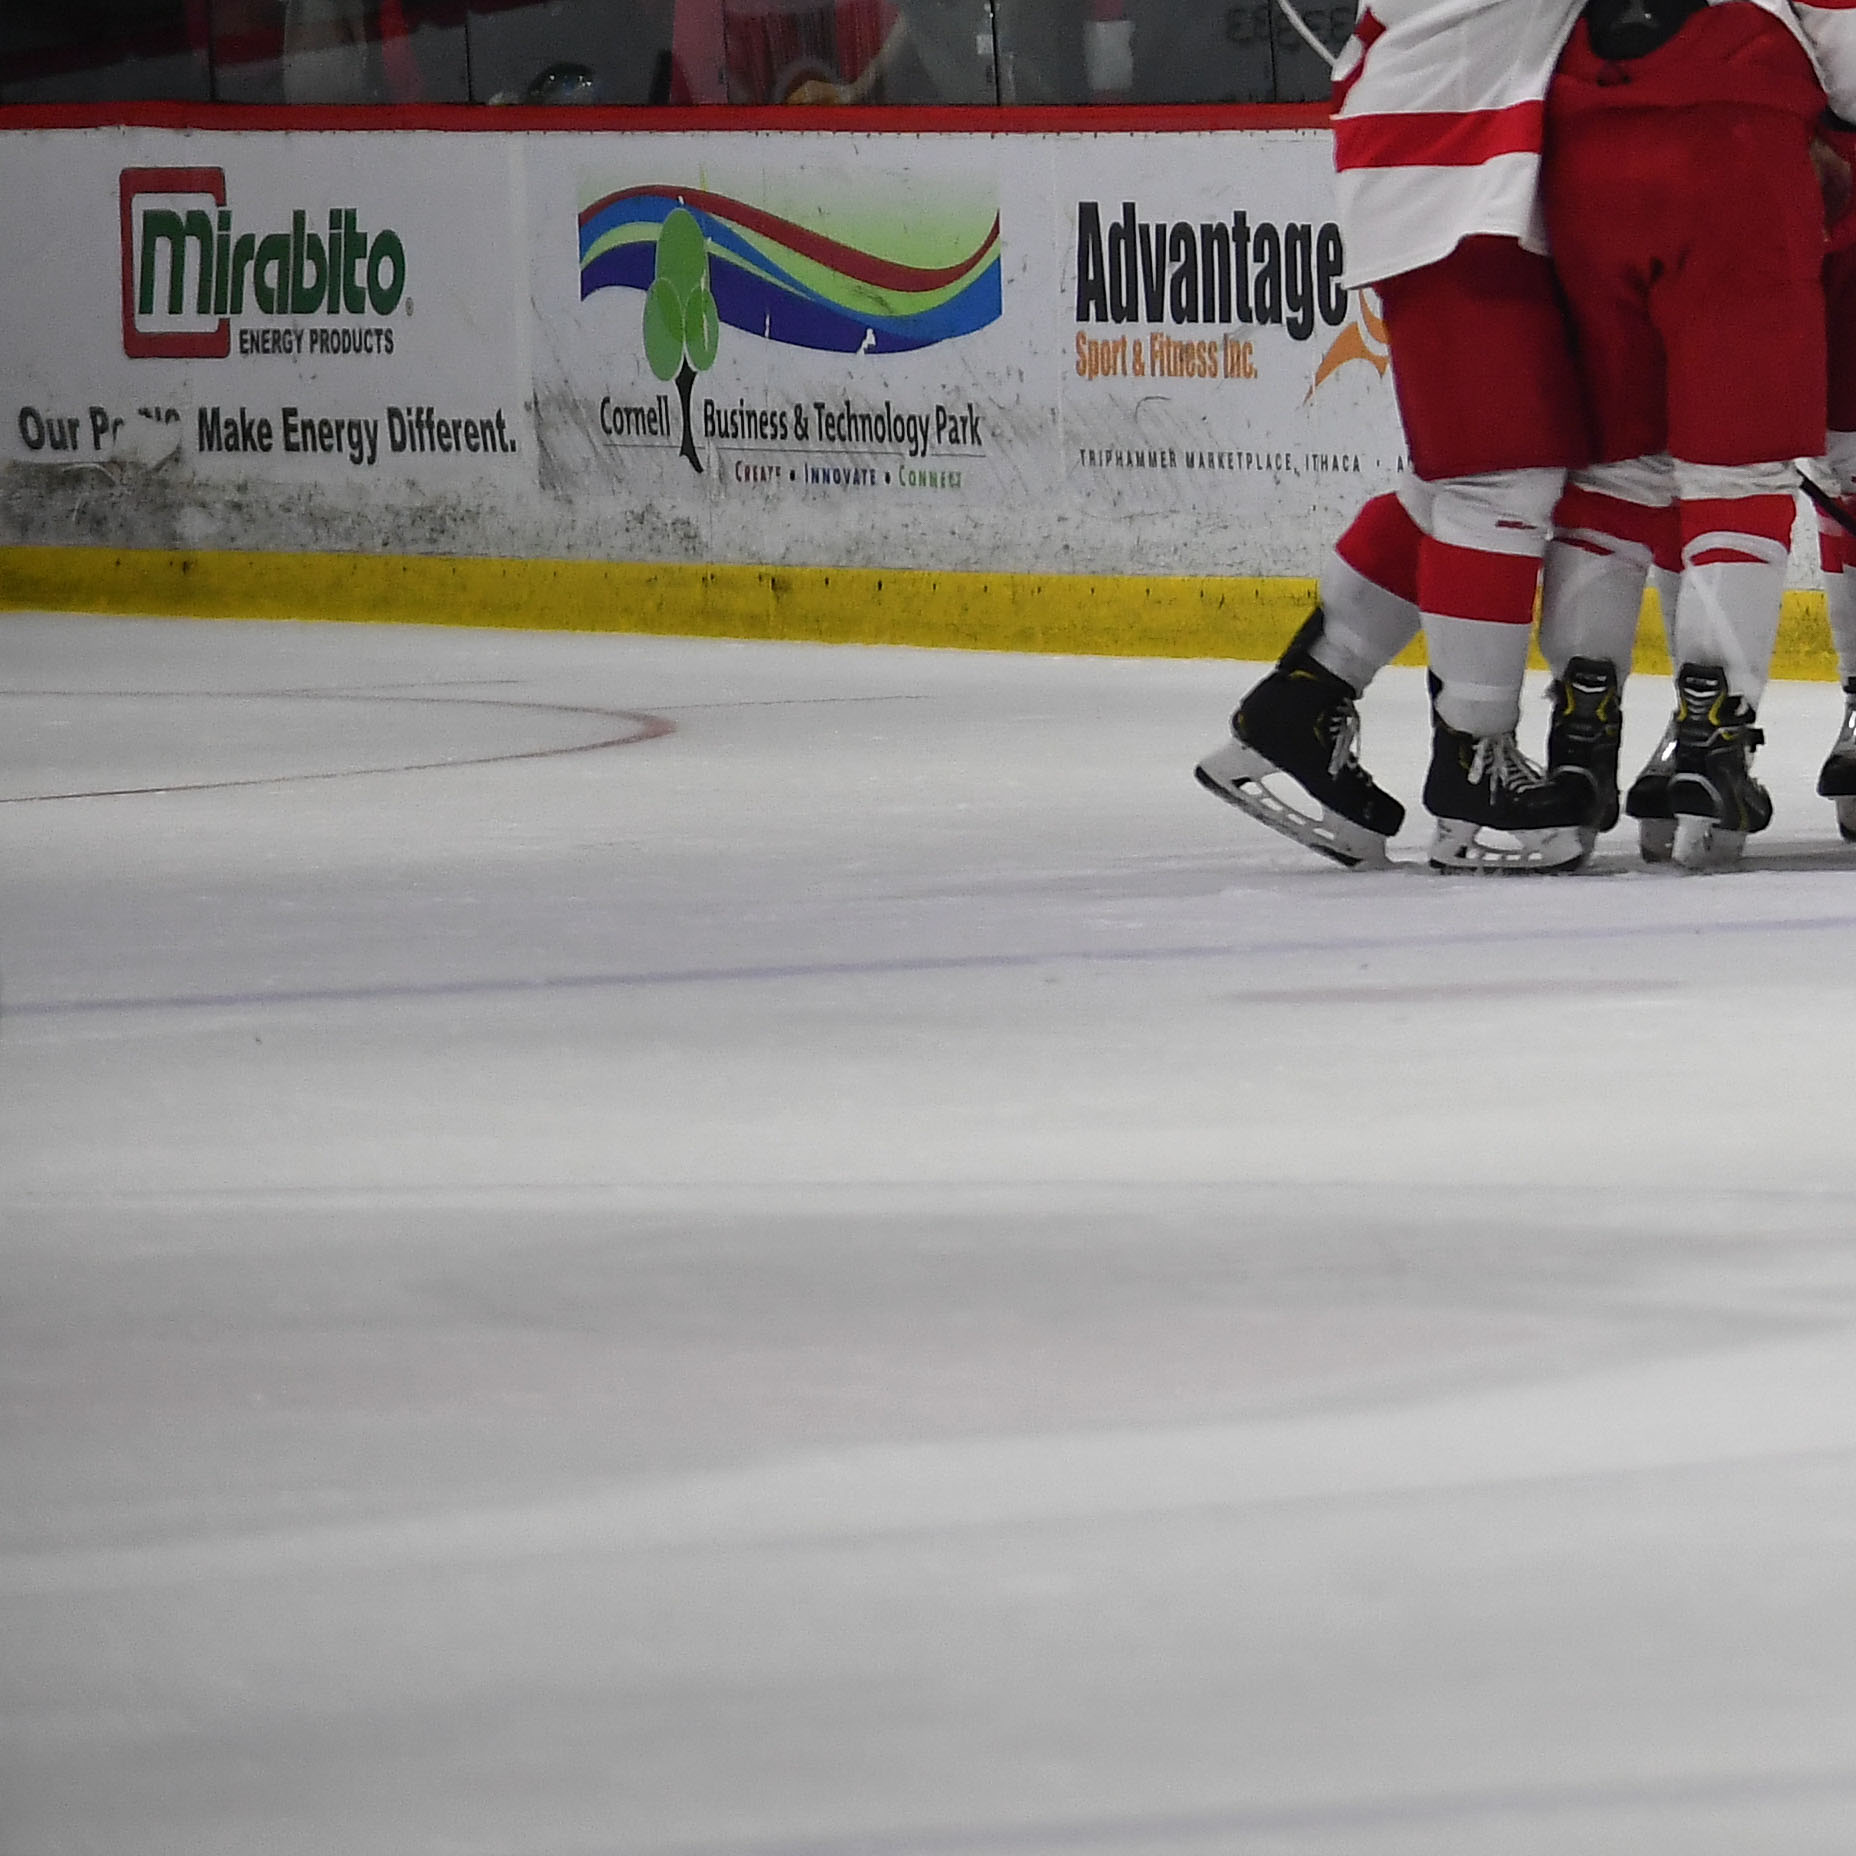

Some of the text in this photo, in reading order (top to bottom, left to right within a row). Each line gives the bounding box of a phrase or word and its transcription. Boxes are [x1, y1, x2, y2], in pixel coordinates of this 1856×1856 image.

[138, 207, 406, 316] Mirabito
[1075, 201, 1348, 341] Advantage
[239, 328, 395, 355] ENERGY PRODUCTS
[1075, 330, 1259, 380] Sport & Fitness Inc.
[18, 406, 80, 450] Our
[198, 406, 273, 453] Make
[282, 406, 379, 465] Energy
[387, 406, 517, 453] Different.
[599, 394, 984, 457] Cornell Business & Technology Park
[803, 462, 877, 487] INNOVATE
[1079, 447, 1178, 469] TRIPHAMMER
[1305, 451, 1361, 473] ITHACA
